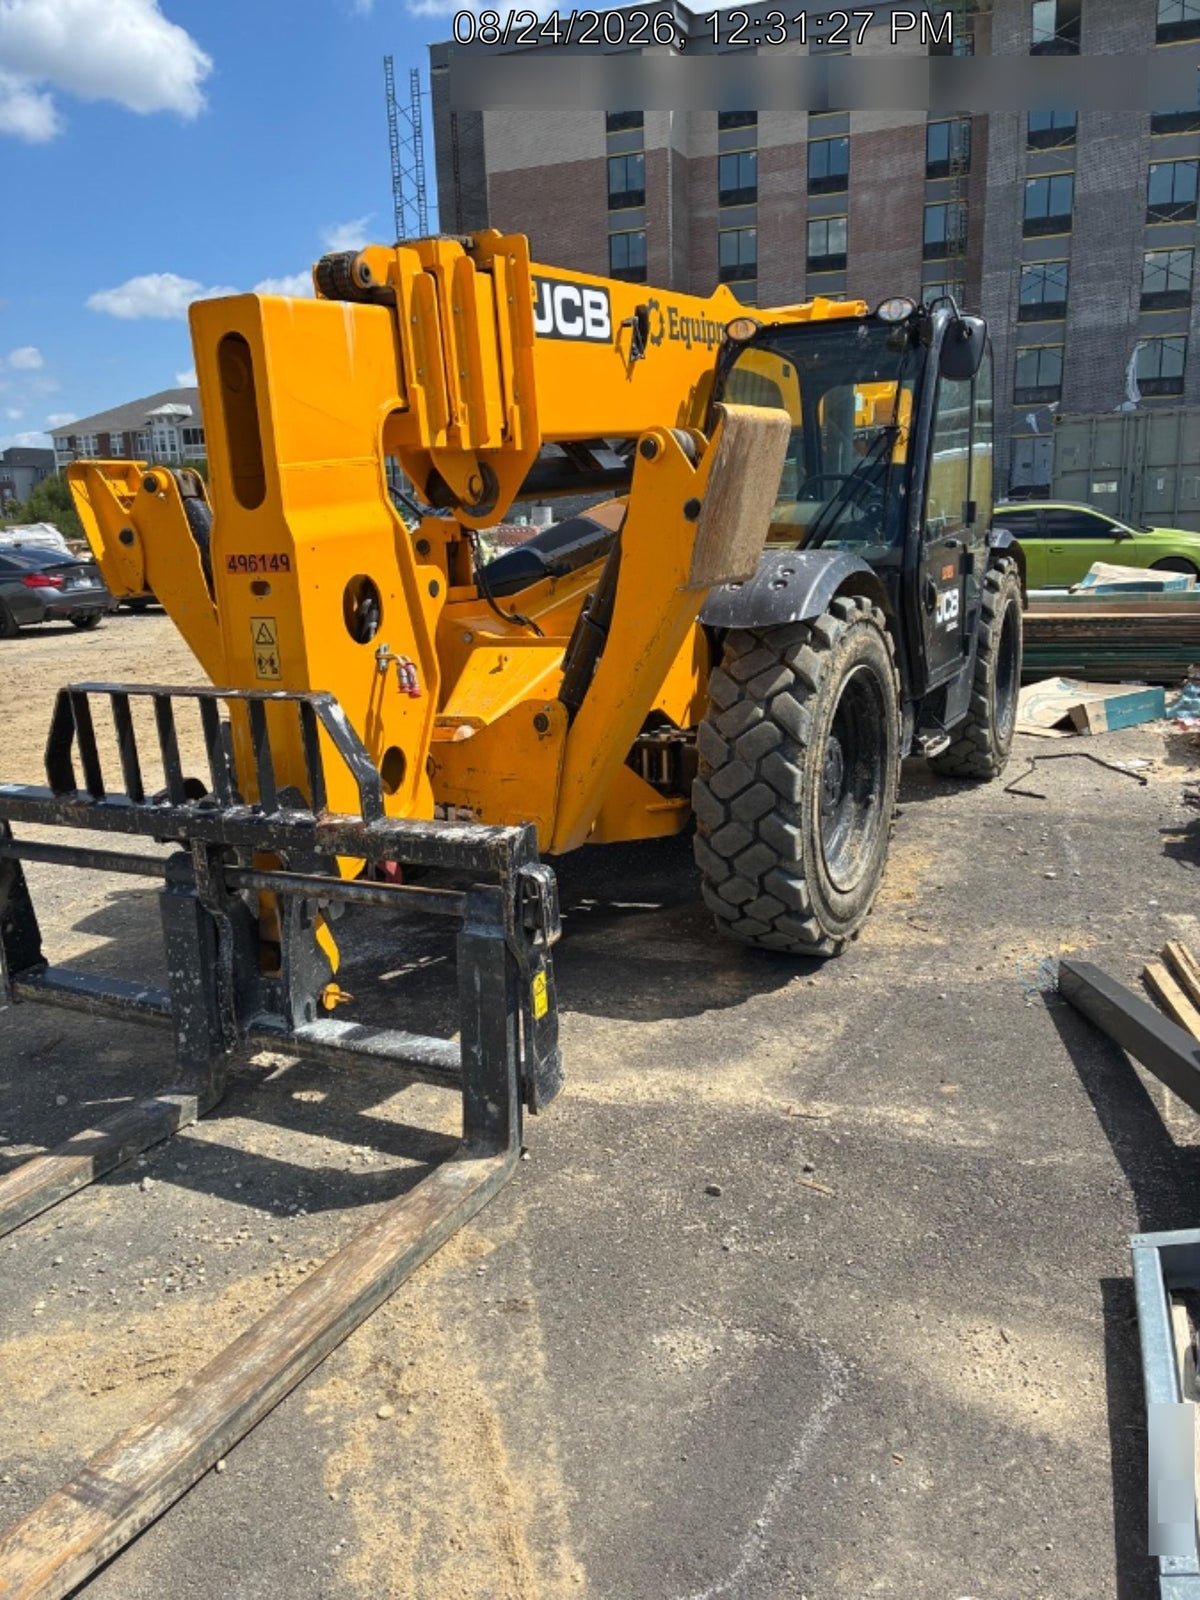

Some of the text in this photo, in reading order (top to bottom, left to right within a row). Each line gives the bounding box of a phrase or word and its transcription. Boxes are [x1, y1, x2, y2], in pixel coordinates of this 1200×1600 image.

[533, 282, 611, 339] JCB
[227, 553, 291, 573] 496149
[936, 588, 959, 624] JCB
